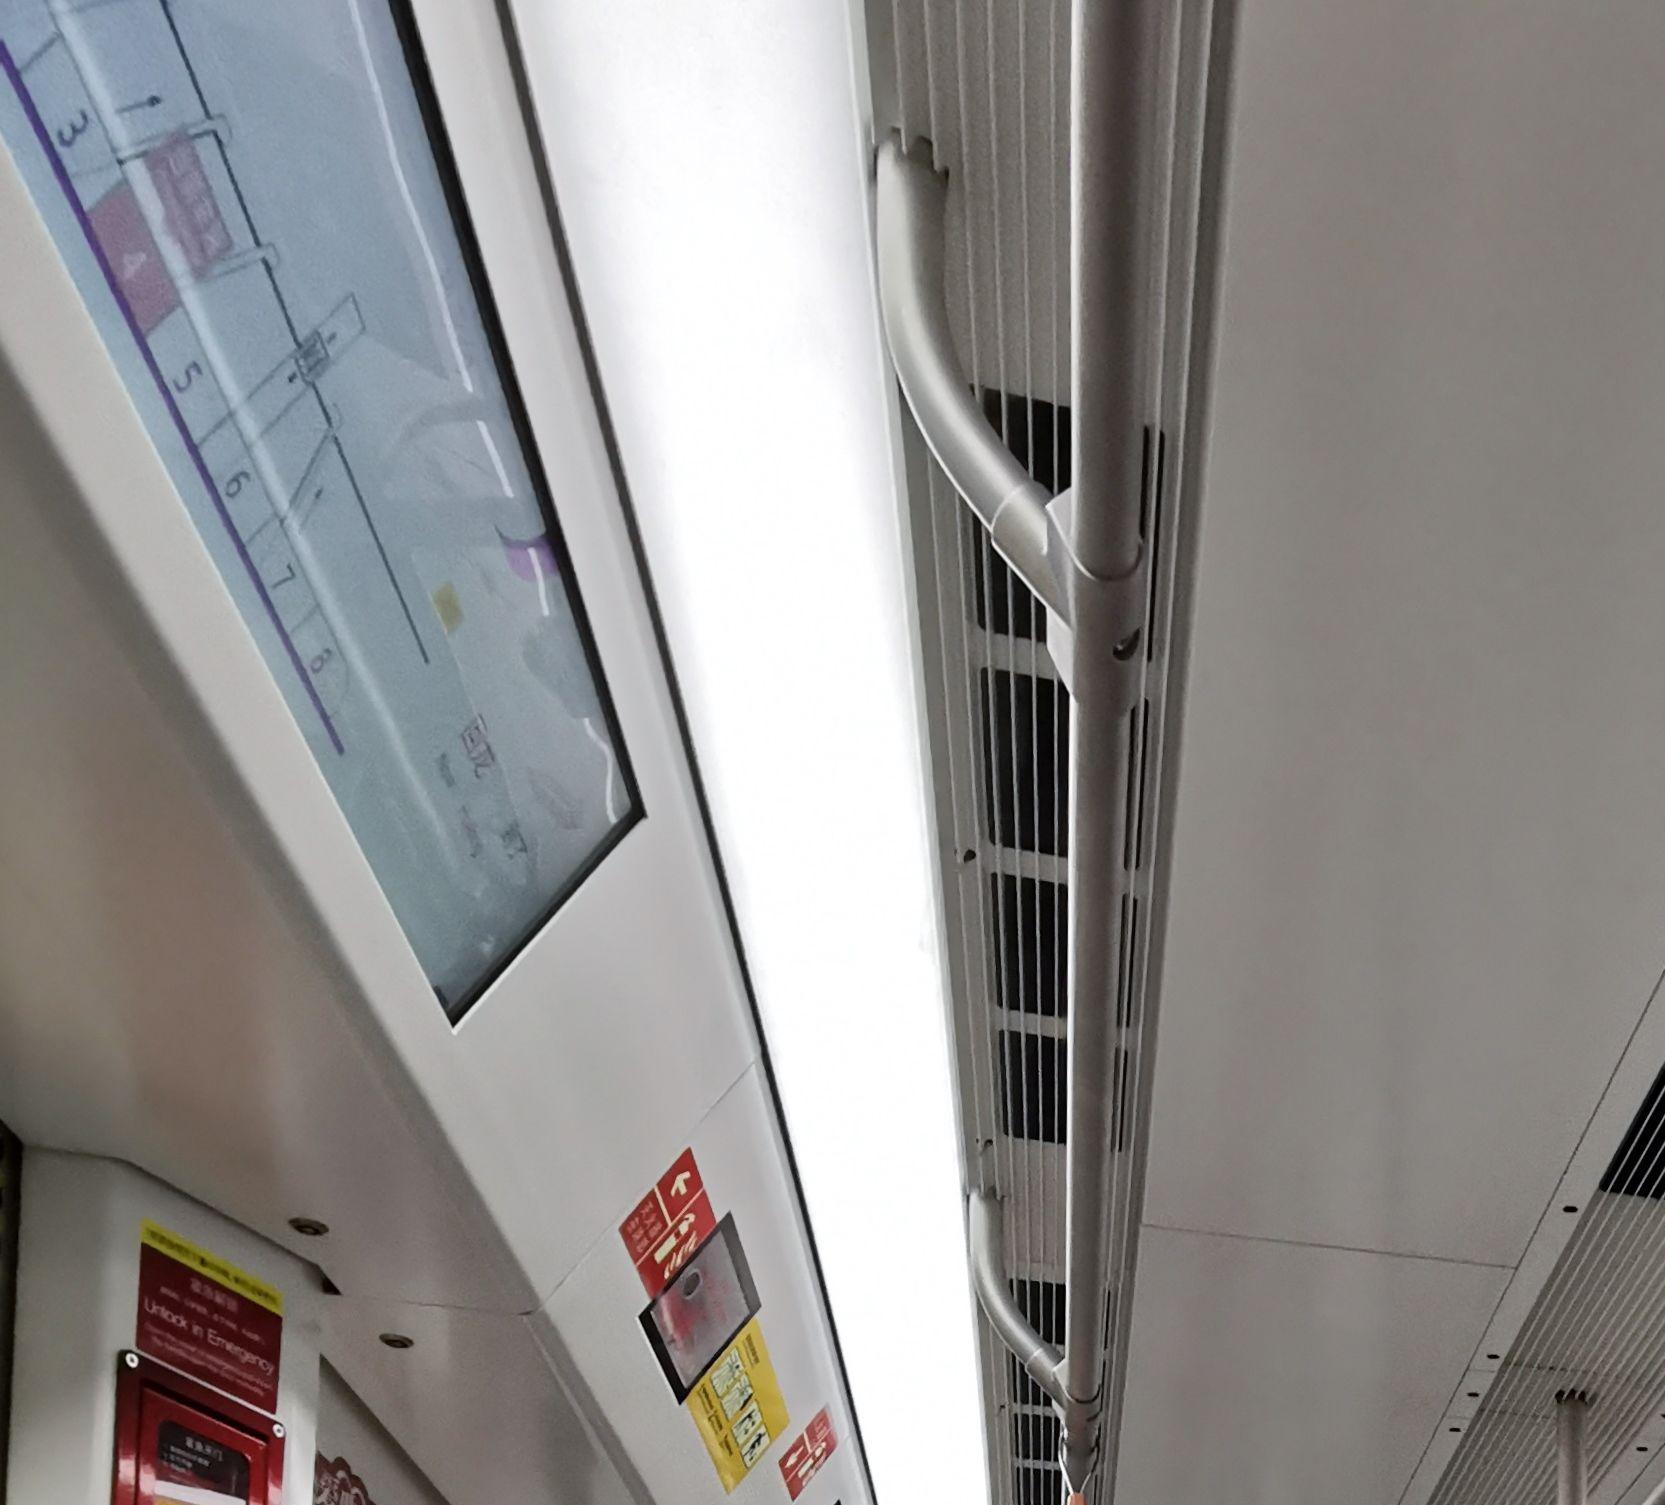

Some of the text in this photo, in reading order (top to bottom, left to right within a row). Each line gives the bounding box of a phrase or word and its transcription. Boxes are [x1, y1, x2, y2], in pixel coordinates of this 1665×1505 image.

[173, 361, 202, 393] 5
[225, 470, 250, 498] 6
[271, 563, 297, 589] 7
[207, 1328, 275, 1376] Emergency
